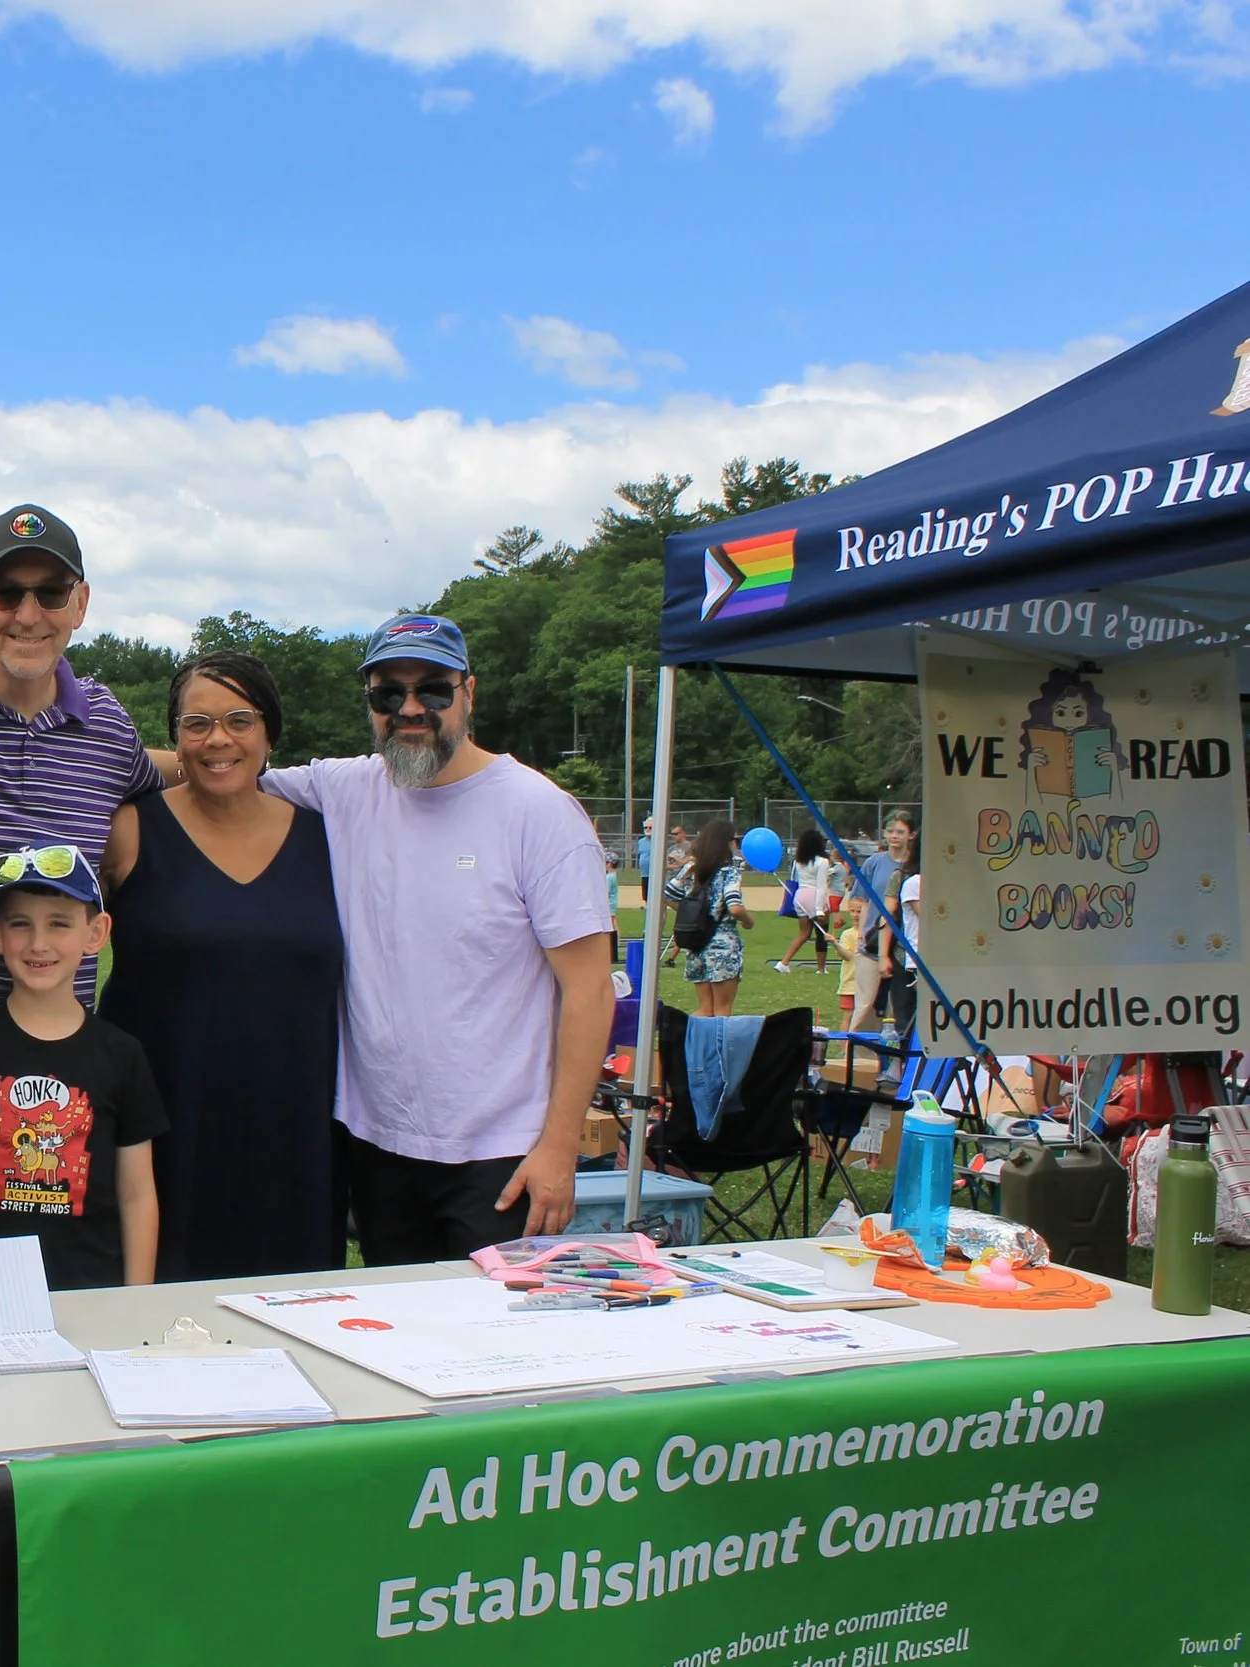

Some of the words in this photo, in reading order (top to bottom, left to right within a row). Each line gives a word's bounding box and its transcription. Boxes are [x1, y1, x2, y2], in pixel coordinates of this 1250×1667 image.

[836, 495, 1028, 571] Reading's
[1035, 466, 1153, 531] POP
[1155, 452, 1250, 509] Hu
[937, 734, 1008, 778] WE
[1129, 738, 1231, 780] READ
[977, 799, 1161, 874] BANNED
[998, 882, 1136, 931] BOOKS!
[930, 987, 1240, 1042] pophuddle.org
[14, 1080, 61, 1106] HONK!
[1, 1201, 35, 1213] STREET
[40, 1203, 70, 1214] BANDS
[6, 1181, 42, 1191] FESTIVAL
[7, 1189, 65, 1202] ACTIVIST
[409, 1457, 498, 1528] Ad
[519, 1449, 640, 1514] Hoc
[656, 1390, 1105, 1493] Commemoration
[376, 1517, 805, 1638] Establishment
[817, 1480, 1099, 1559] Committee
[673, 1646, 722, 1667] more
[726, 1625, 789, 1660] about
[794, 1618, 829, 1645] the
[834, 1600, 949, 1638] committee
[852, 1639, 888, 1667] Bill
[894, 1627, 970, 1663] Russell
[1179, 1637, 1219, 1655] Town
[1223, 1632, 1242, 1651] of
